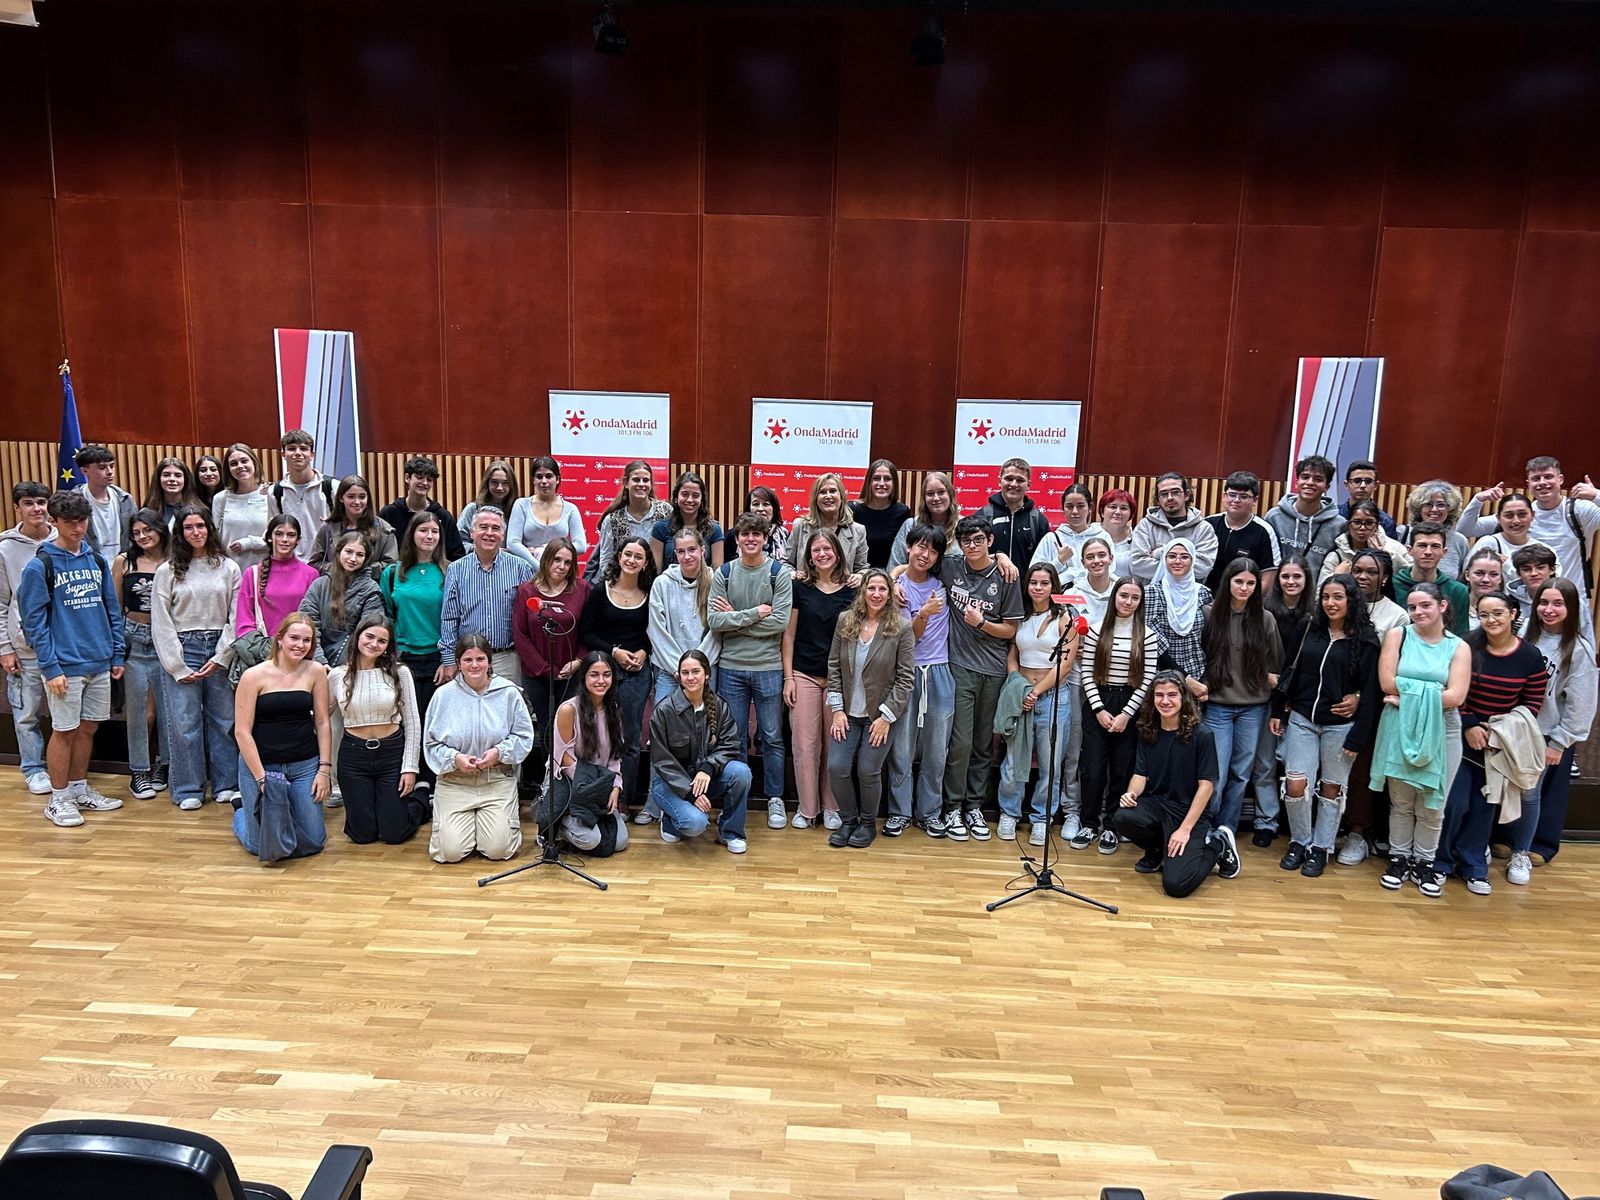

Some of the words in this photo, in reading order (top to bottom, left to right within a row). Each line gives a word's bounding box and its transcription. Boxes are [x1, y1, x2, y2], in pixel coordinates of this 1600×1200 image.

[592, 418, 657, 430] OndaMadrid
[793, 426, 859, 439] OndaMadrid
[998, 426, 1066, 438] OndaMadrid
